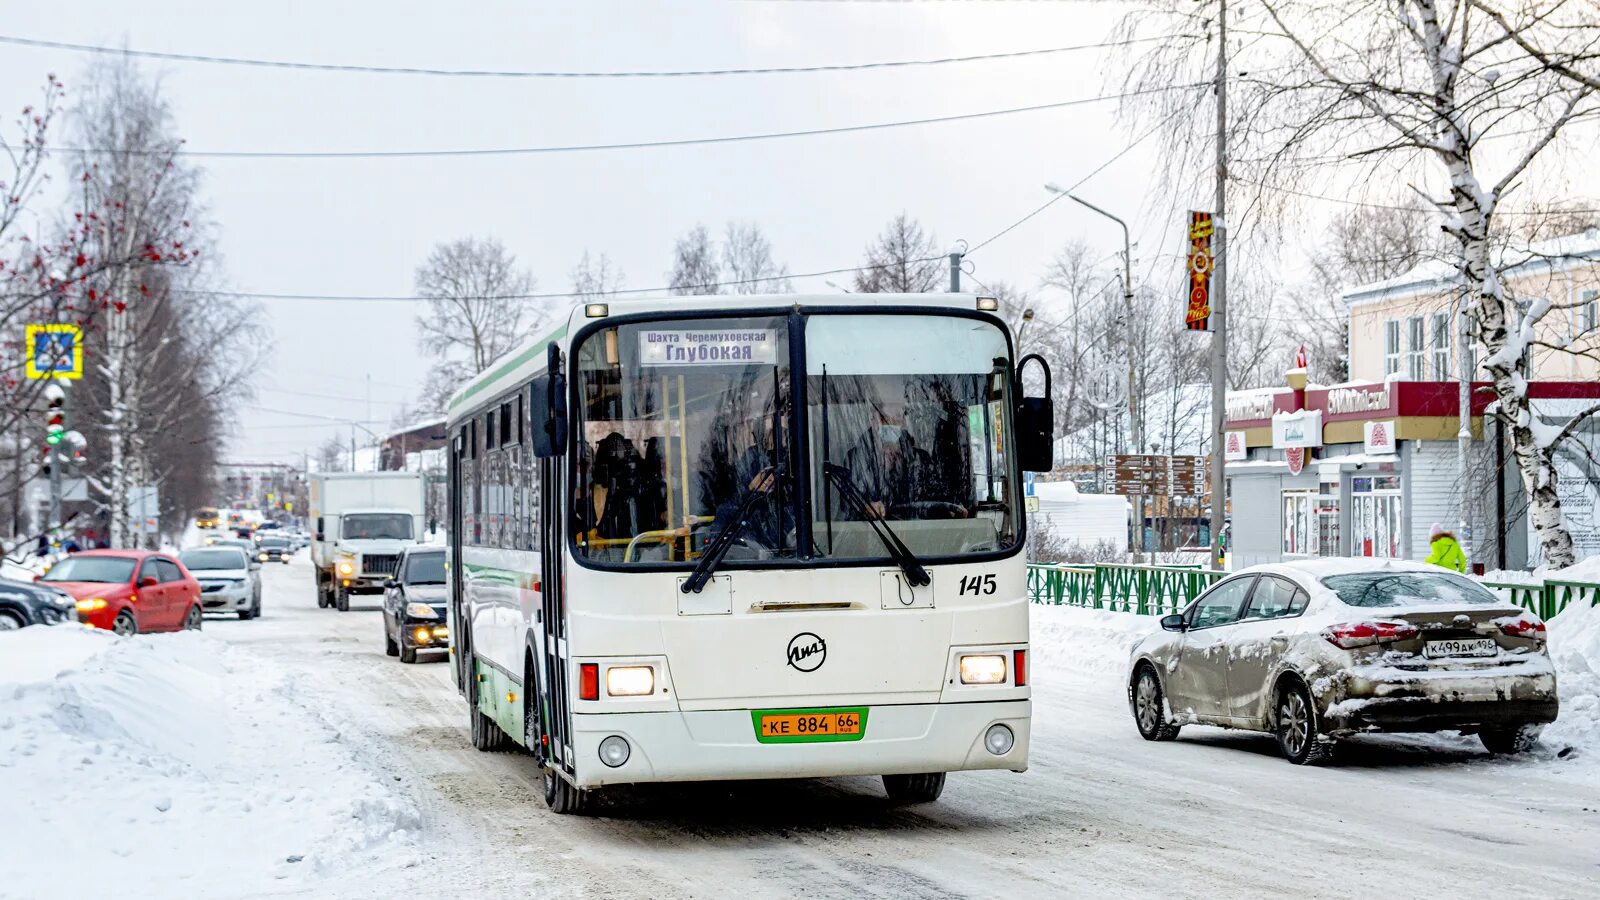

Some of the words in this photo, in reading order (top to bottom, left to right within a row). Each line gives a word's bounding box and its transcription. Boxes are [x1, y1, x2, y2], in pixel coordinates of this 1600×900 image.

[1191, 286, 1208, 311] 9
[647, 332, 680, 343] Шахта
[685, 332, 767, 343] Черемуховская
[666, 344, 753, 362] Глубокая
[959, 574, 997, 596] 145
[770, 721, 790, 734] КЕ
[797, 717, 829, 732] 884
[838, 715, 854, 727] 66
